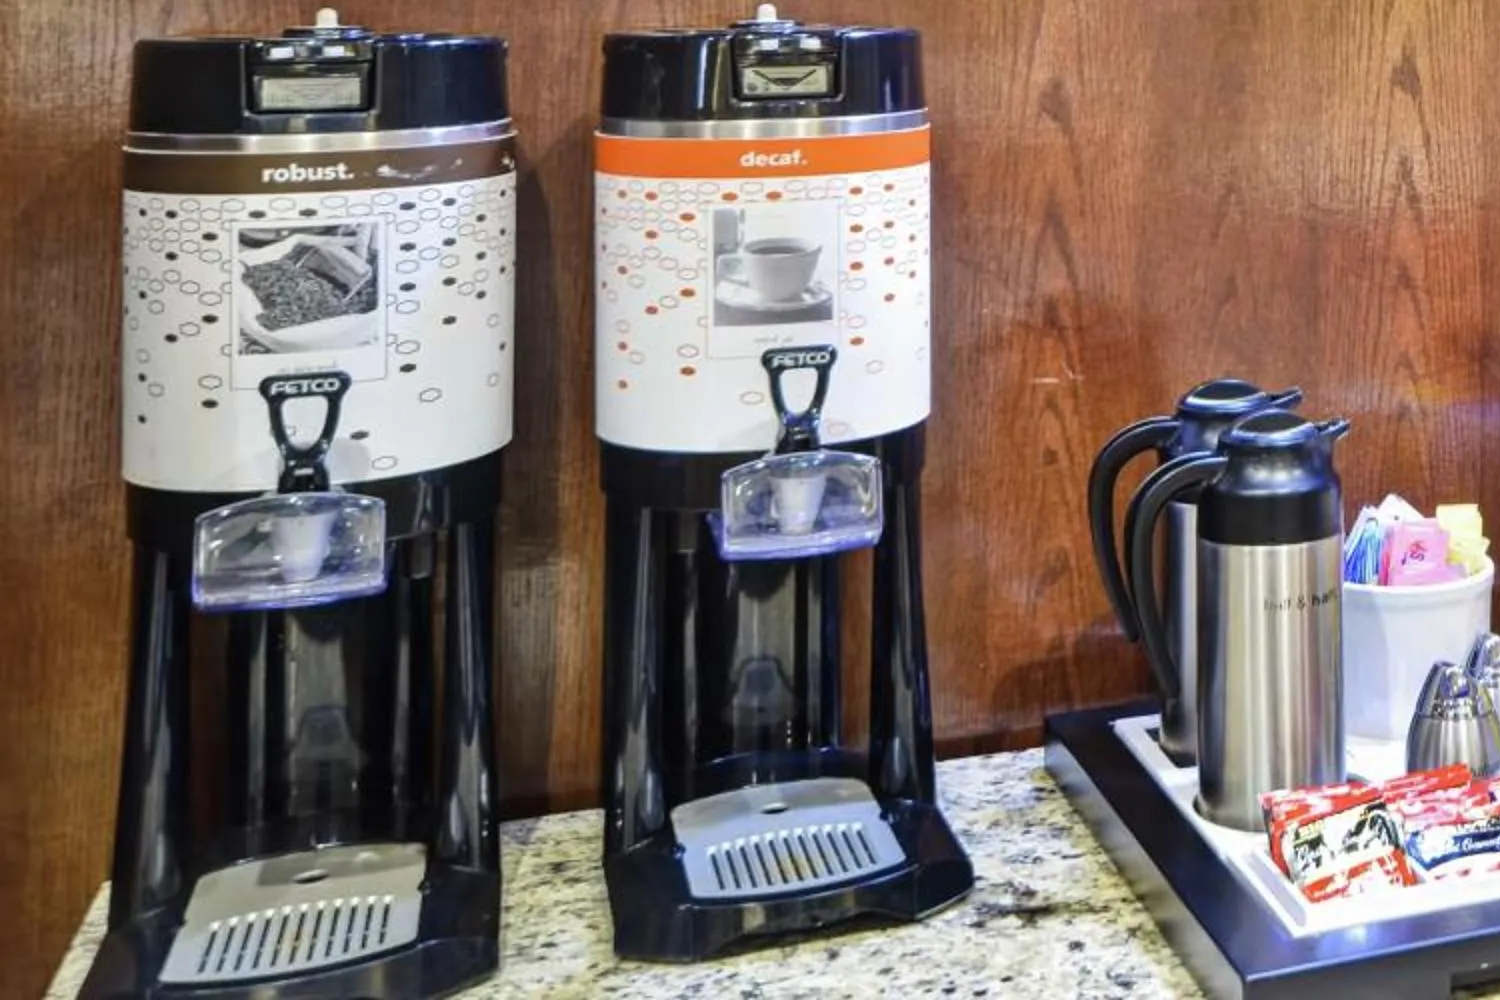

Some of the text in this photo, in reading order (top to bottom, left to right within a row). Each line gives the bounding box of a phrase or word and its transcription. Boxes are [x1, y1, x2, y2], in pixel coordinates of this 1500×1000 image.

[261, 162, 355, 183] robust.
[770, 351, 831, 369] FETCO
[270, 377, 341, 396] FETCO
